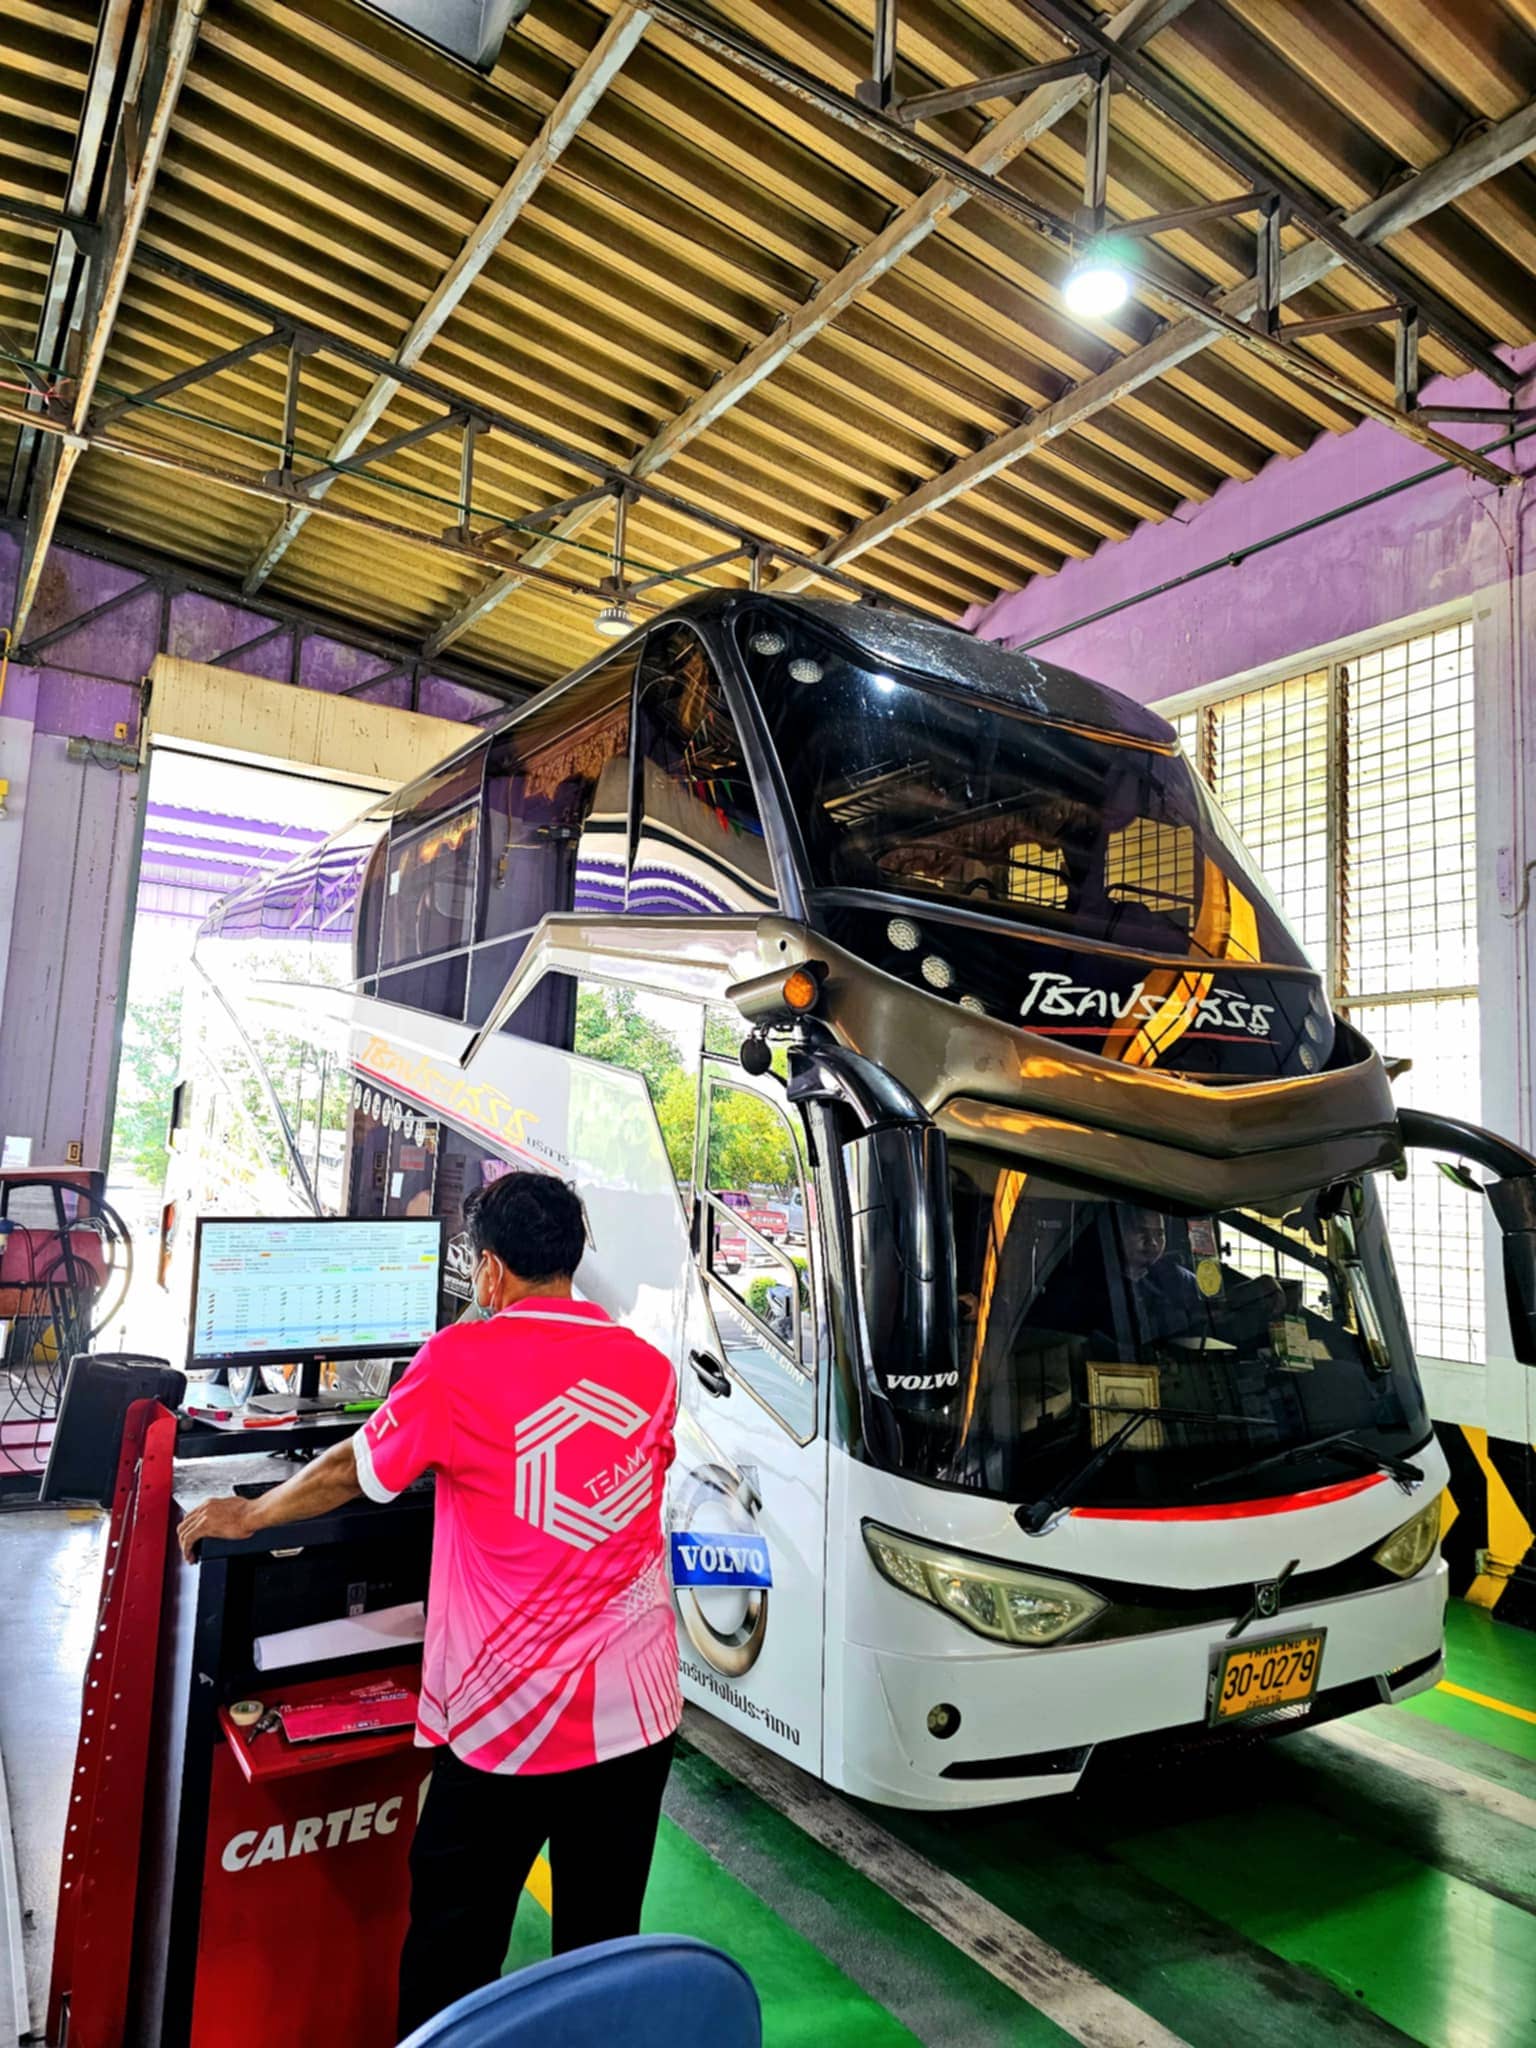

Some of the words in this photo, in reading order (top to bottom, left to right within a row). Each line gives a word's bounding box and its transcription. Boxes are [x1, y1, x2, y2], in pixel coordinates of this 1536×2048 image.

[886, 1370, 959, 1390] VOLVO
[583, 1446, 647, 1500] TEAM
[677, 1544, 765, 1575] VOLVO
[1223, 1649, 1316, 1701] 30-0279
[221, 1796, 404, 1873] CARTEC
